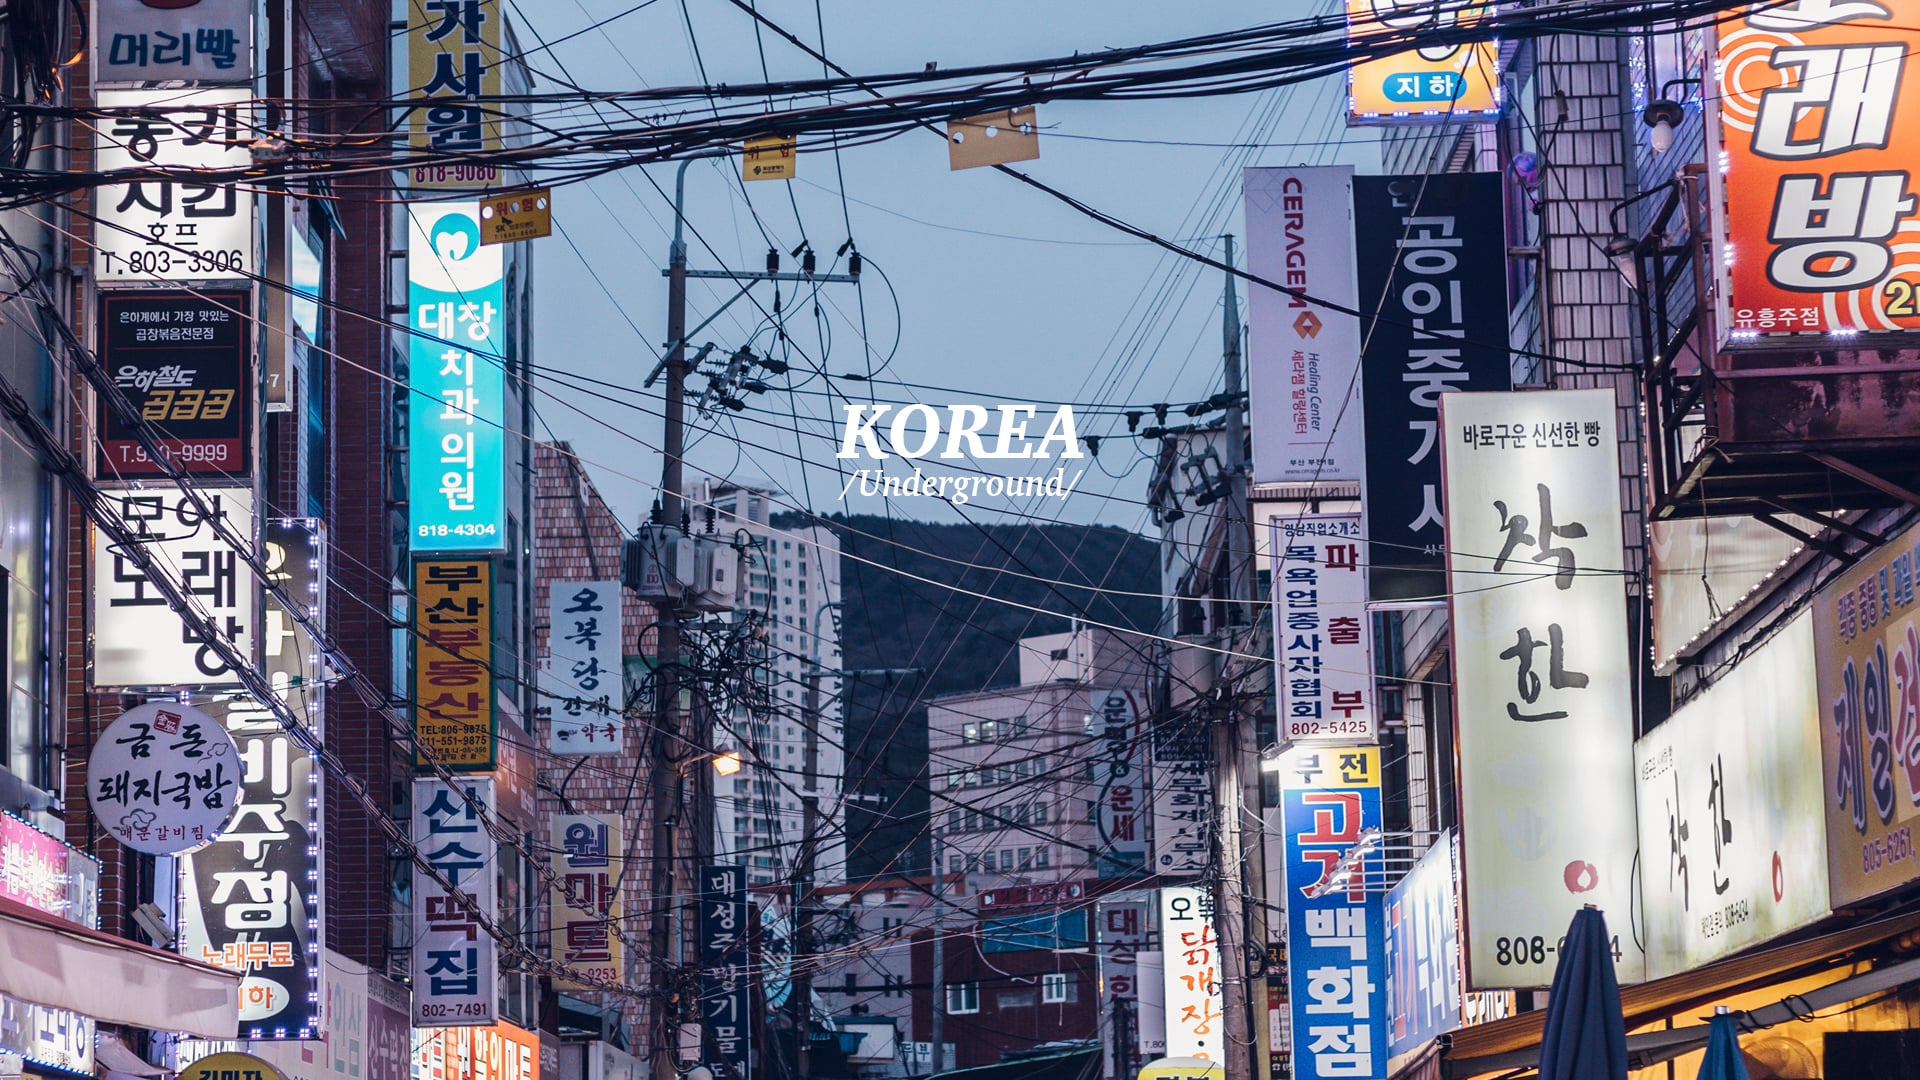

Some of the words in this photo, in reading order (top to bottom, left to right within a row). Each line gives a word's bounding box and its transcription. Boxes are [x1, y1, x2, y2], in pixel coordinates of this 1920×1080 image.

[108, 28, 240, 69] 머리빨
[1396, 75, 1454, 98] 지하
[146, 222, 198, 246] 호프
[1283, 178, 1307, 308] CERAGEM
[174, 311, 194, 322] 가장
[199, 310, 230, 322] 맛있는
[418, 301, 497, 341] 대창
[1735, 307, 1819, 329] 유흥주점
[136, 327, 214, 341] 곱창볶음전문점
[114, 365, 197, 392] 은하철도
[1291, 350, 1306, 385] 세라젬
[1306, 352, 1321, 394] Healing
[1292, 389, 1308, 435] 힐링센터
[1310, 396, 1323, 432] Center
[439, 349, 480, 511] 치과의원
[1463, 424, 1526, 450] 바로구운
[1533, 422, 1580, 448] 신선한
[1584, 421, 1601, 447] 빵
[119, 444, 227, 462] T.9-9999
[122, 495, 227, 541] 모아
[418, 524, 496, 537] 818-4304
[1493, 483, 1589, 722] 착한
[563, 588, 608, 691] 오복당
[1325, 544, 1365, 718] 파출부
[581, 723, 617, 743] 약국
[1291, 721, 1368, 736] 802-5425
[1295, 753, 1369, 784] 부전
[97, 763, 233, 810] 돼지국밥
[563, 823, 612, 962] 원마트
[203, 942, 294, 969] 노래무료
[1496, 935, 1623, 966] 808-4
[1179, 924, 1223, 1035] 닭개장
[421, 1002, 487, 1018] 802-7491
